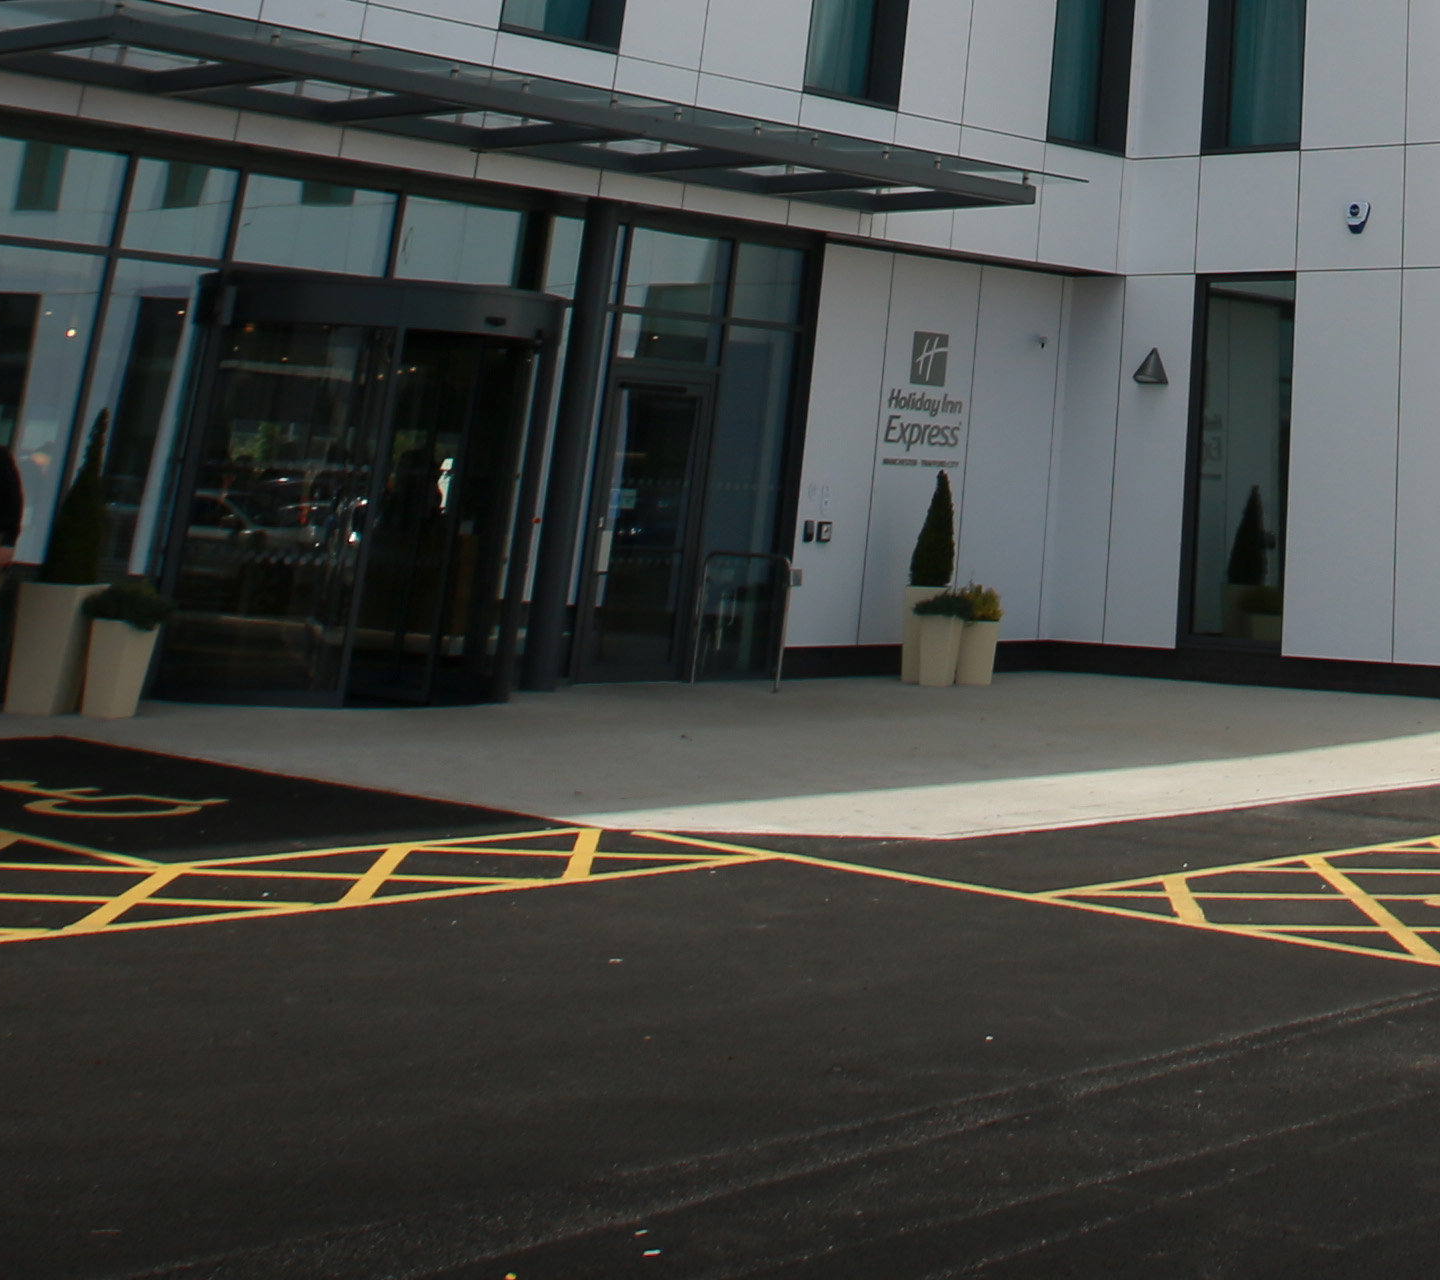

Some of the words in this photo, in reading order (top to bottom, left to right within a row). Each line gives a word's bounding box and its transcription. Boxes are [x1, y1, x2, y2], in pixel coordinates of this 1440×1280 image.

[888, 388, 941, 417] Holiday
[941, 393, 963, 415] Inn
[884, 414, 960, 452] Express
